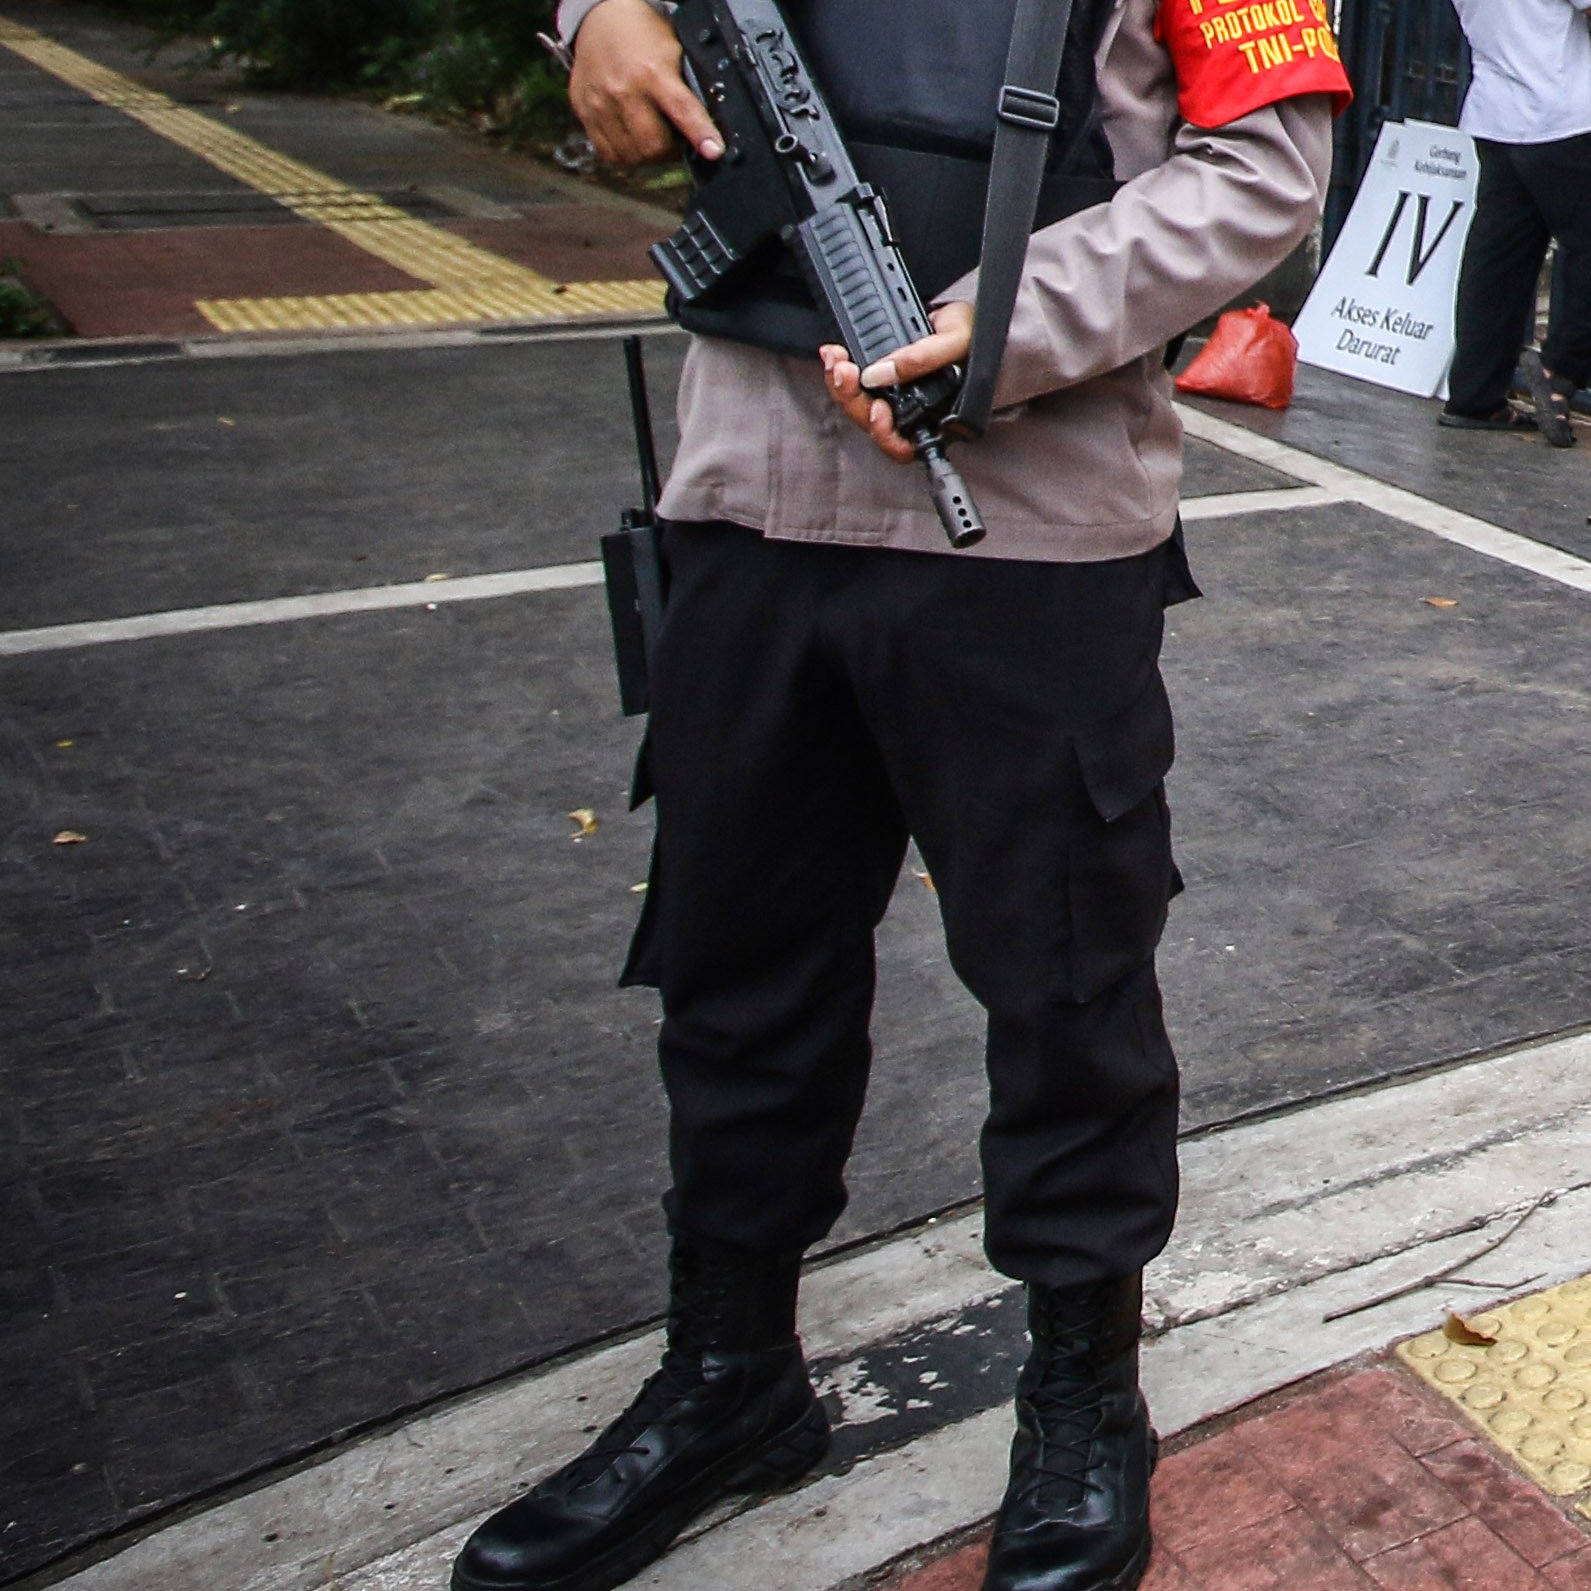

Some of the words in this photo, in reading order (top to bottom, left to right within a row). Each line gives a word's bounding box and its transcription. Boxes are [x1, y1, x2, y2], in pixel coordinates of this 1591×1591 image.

[1364, 189, 1465, 286] IV
[1330, 296, 1378, 327] Akses
[1380, 306, 1434, 341] Keluar
[1335, 328, 1401, 366] Darurat
